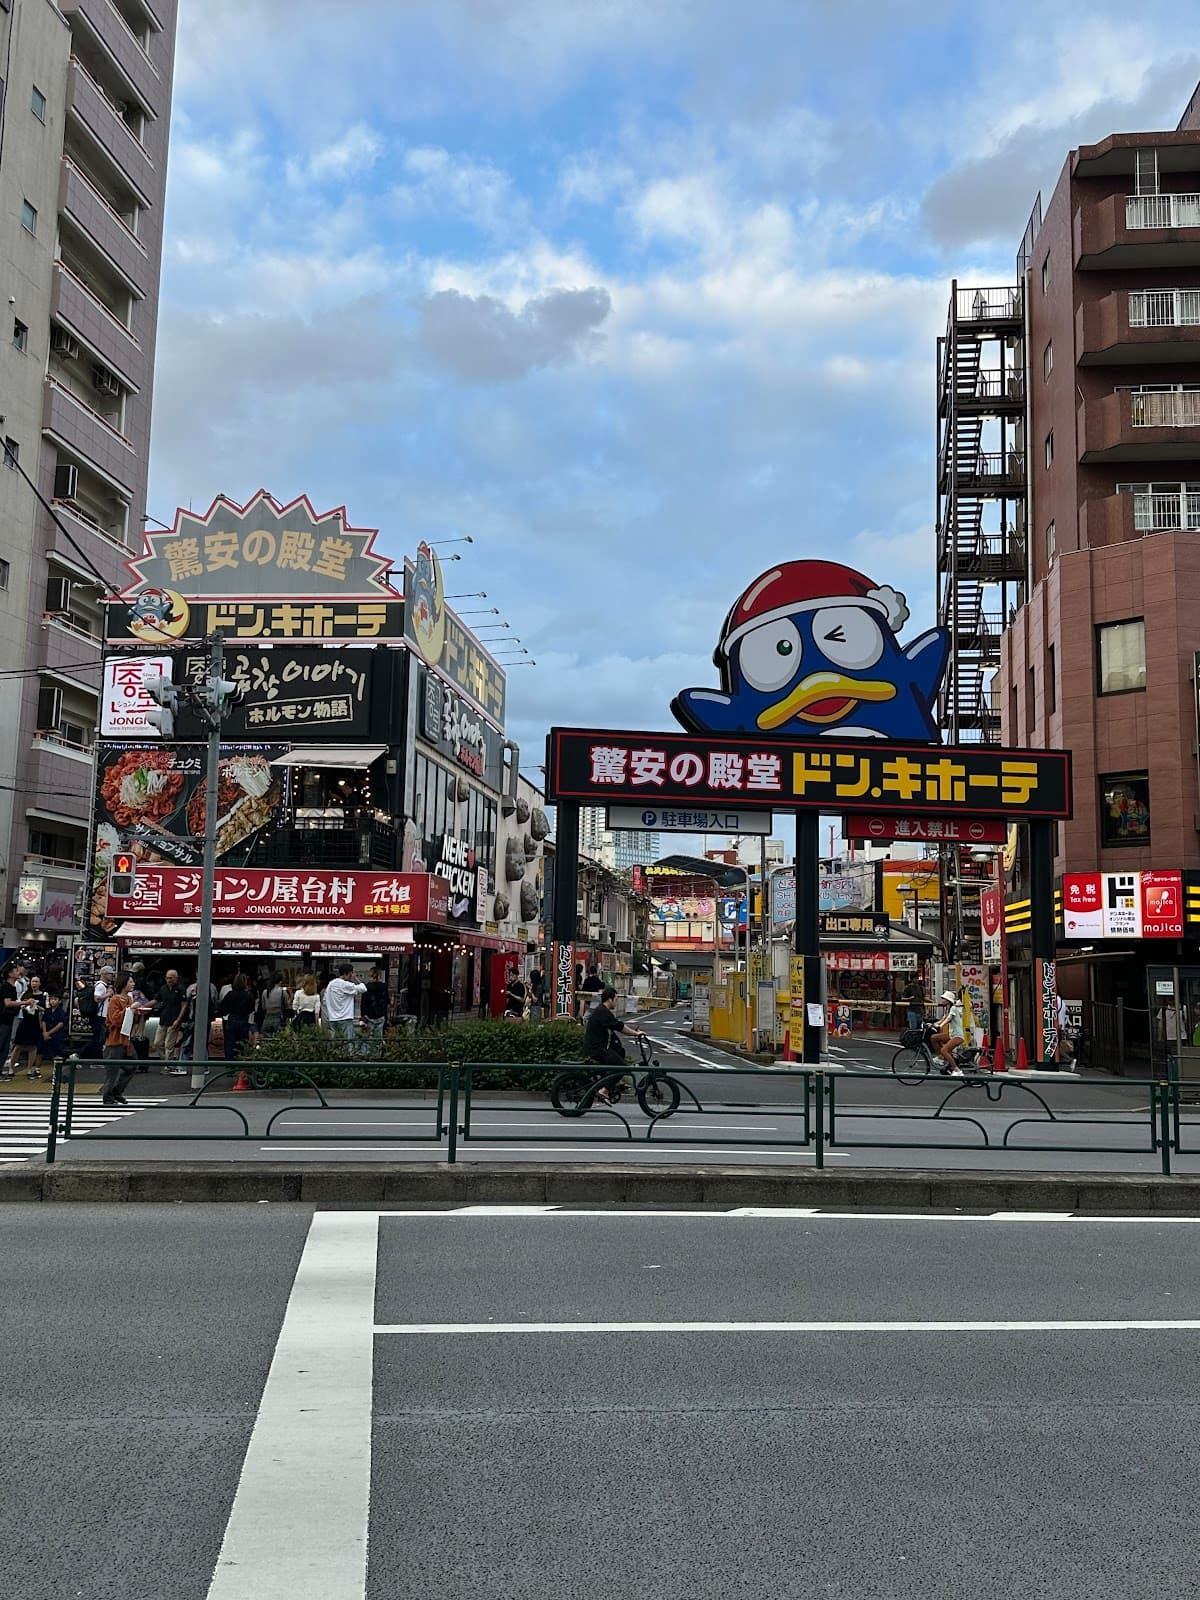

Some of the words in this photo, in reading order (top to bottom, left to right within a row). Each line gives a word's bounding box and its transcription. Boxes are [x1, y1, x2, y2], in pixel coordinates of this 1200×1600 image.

[163, 529, 354, 582] 驚安の殿堂
[249, 699, 349, 724] ホルモン物語
[110, 717, 147, 725] JONG
[167, 757, 202, 769] チュクミ
[590, 746, 782, 791] 驚安の殿堂
[661, 811, 740, 829] 駐車場入口
[895, 820, 960, 838] 進入禁止
[442, 833, 469, 868] NENE
[371, 879, 411, 903] 元祖
[1069, 884, 1097, 894] 免税
[1107, 876, 1134, 908] ド
[364, 904, 411, 914] 日本1号店
[1070, 896, 1082, 904] Tax
[245, 905, 286, 914] JONGNO
[289, 906, 346, 915] YATAIMURA
[1143, 922, 1182, 933] majica
